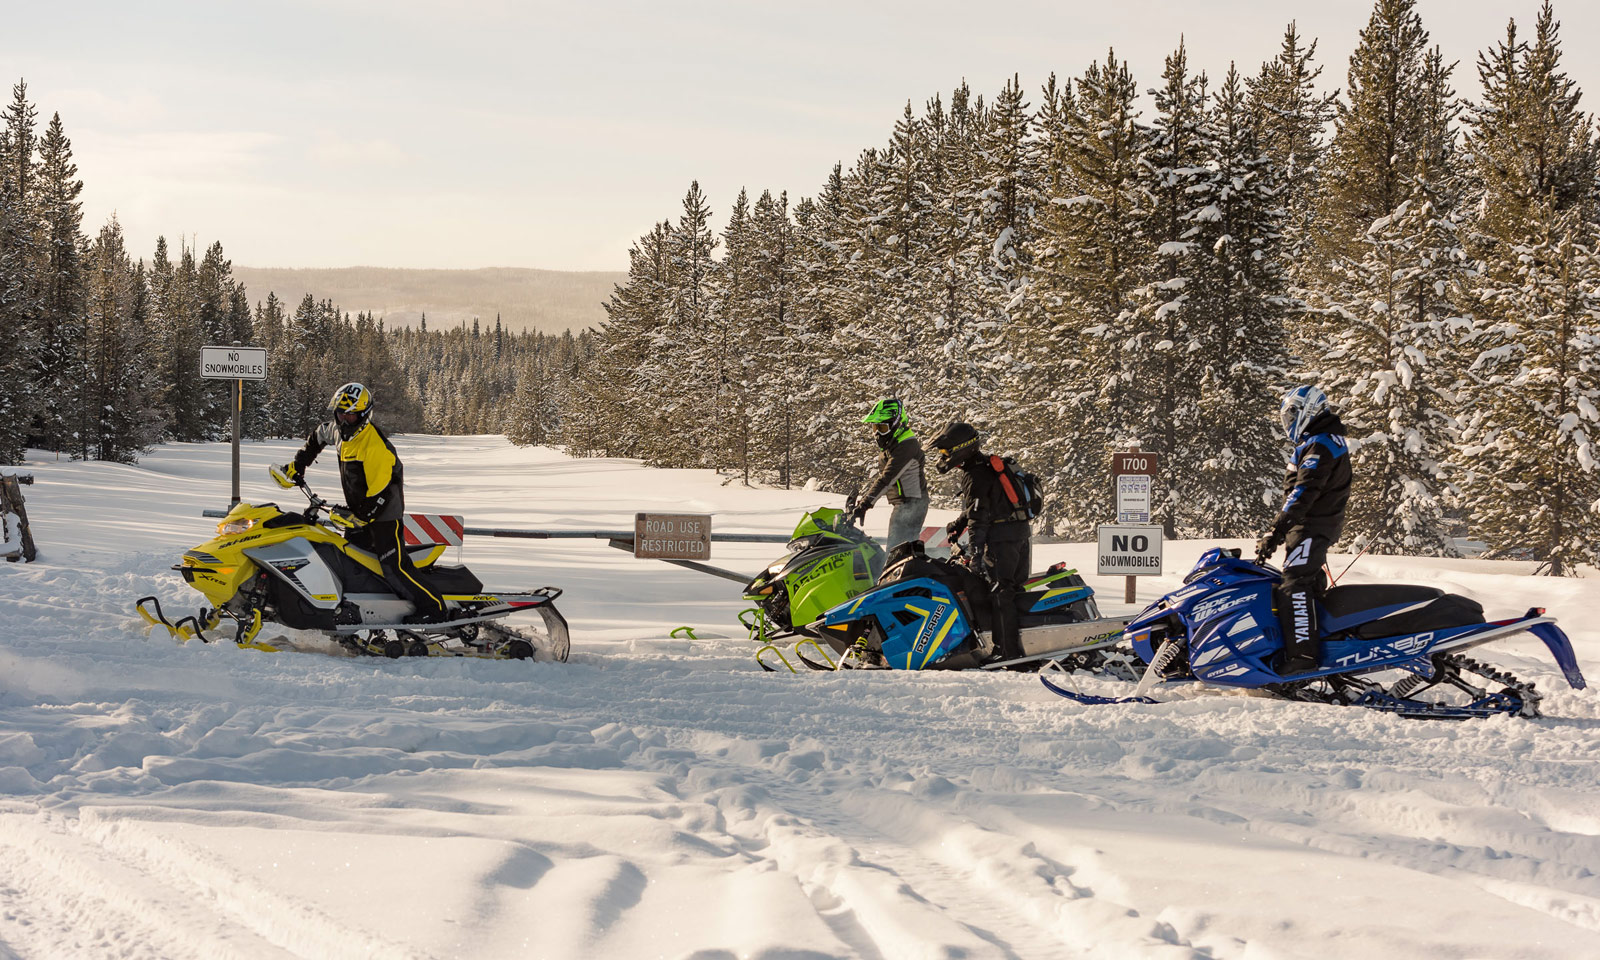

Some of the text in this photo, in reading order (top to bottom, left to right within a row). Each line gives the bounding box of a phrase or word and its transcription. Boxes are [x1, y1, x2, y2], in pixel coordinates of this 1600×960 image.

[228, 352, 240, 362] NO
[205, 364, 263, 375] SNOWMOBILES
[1122, 458, 1148, 471] 1700
[646, 520, 701, 534] ROAD USE
[641, 539, 704, 553] RESTRICTED
[1112, 535, 1148, 552] NO
[830, 551, 852, 561] TEAM
[1100, 555, 1160, 567] SNOWMOBILES
[793, 558, 846, 595] ARCTIC
[1044, 592, 1080, 607] POLARIS
[1192, 595, 1232, 612] SIDE
[1291, 591, 1310, 644] YAMAHA
[915, 603, 946, 654] POLARIS
[1083, 631, 1115, 643] INDY
